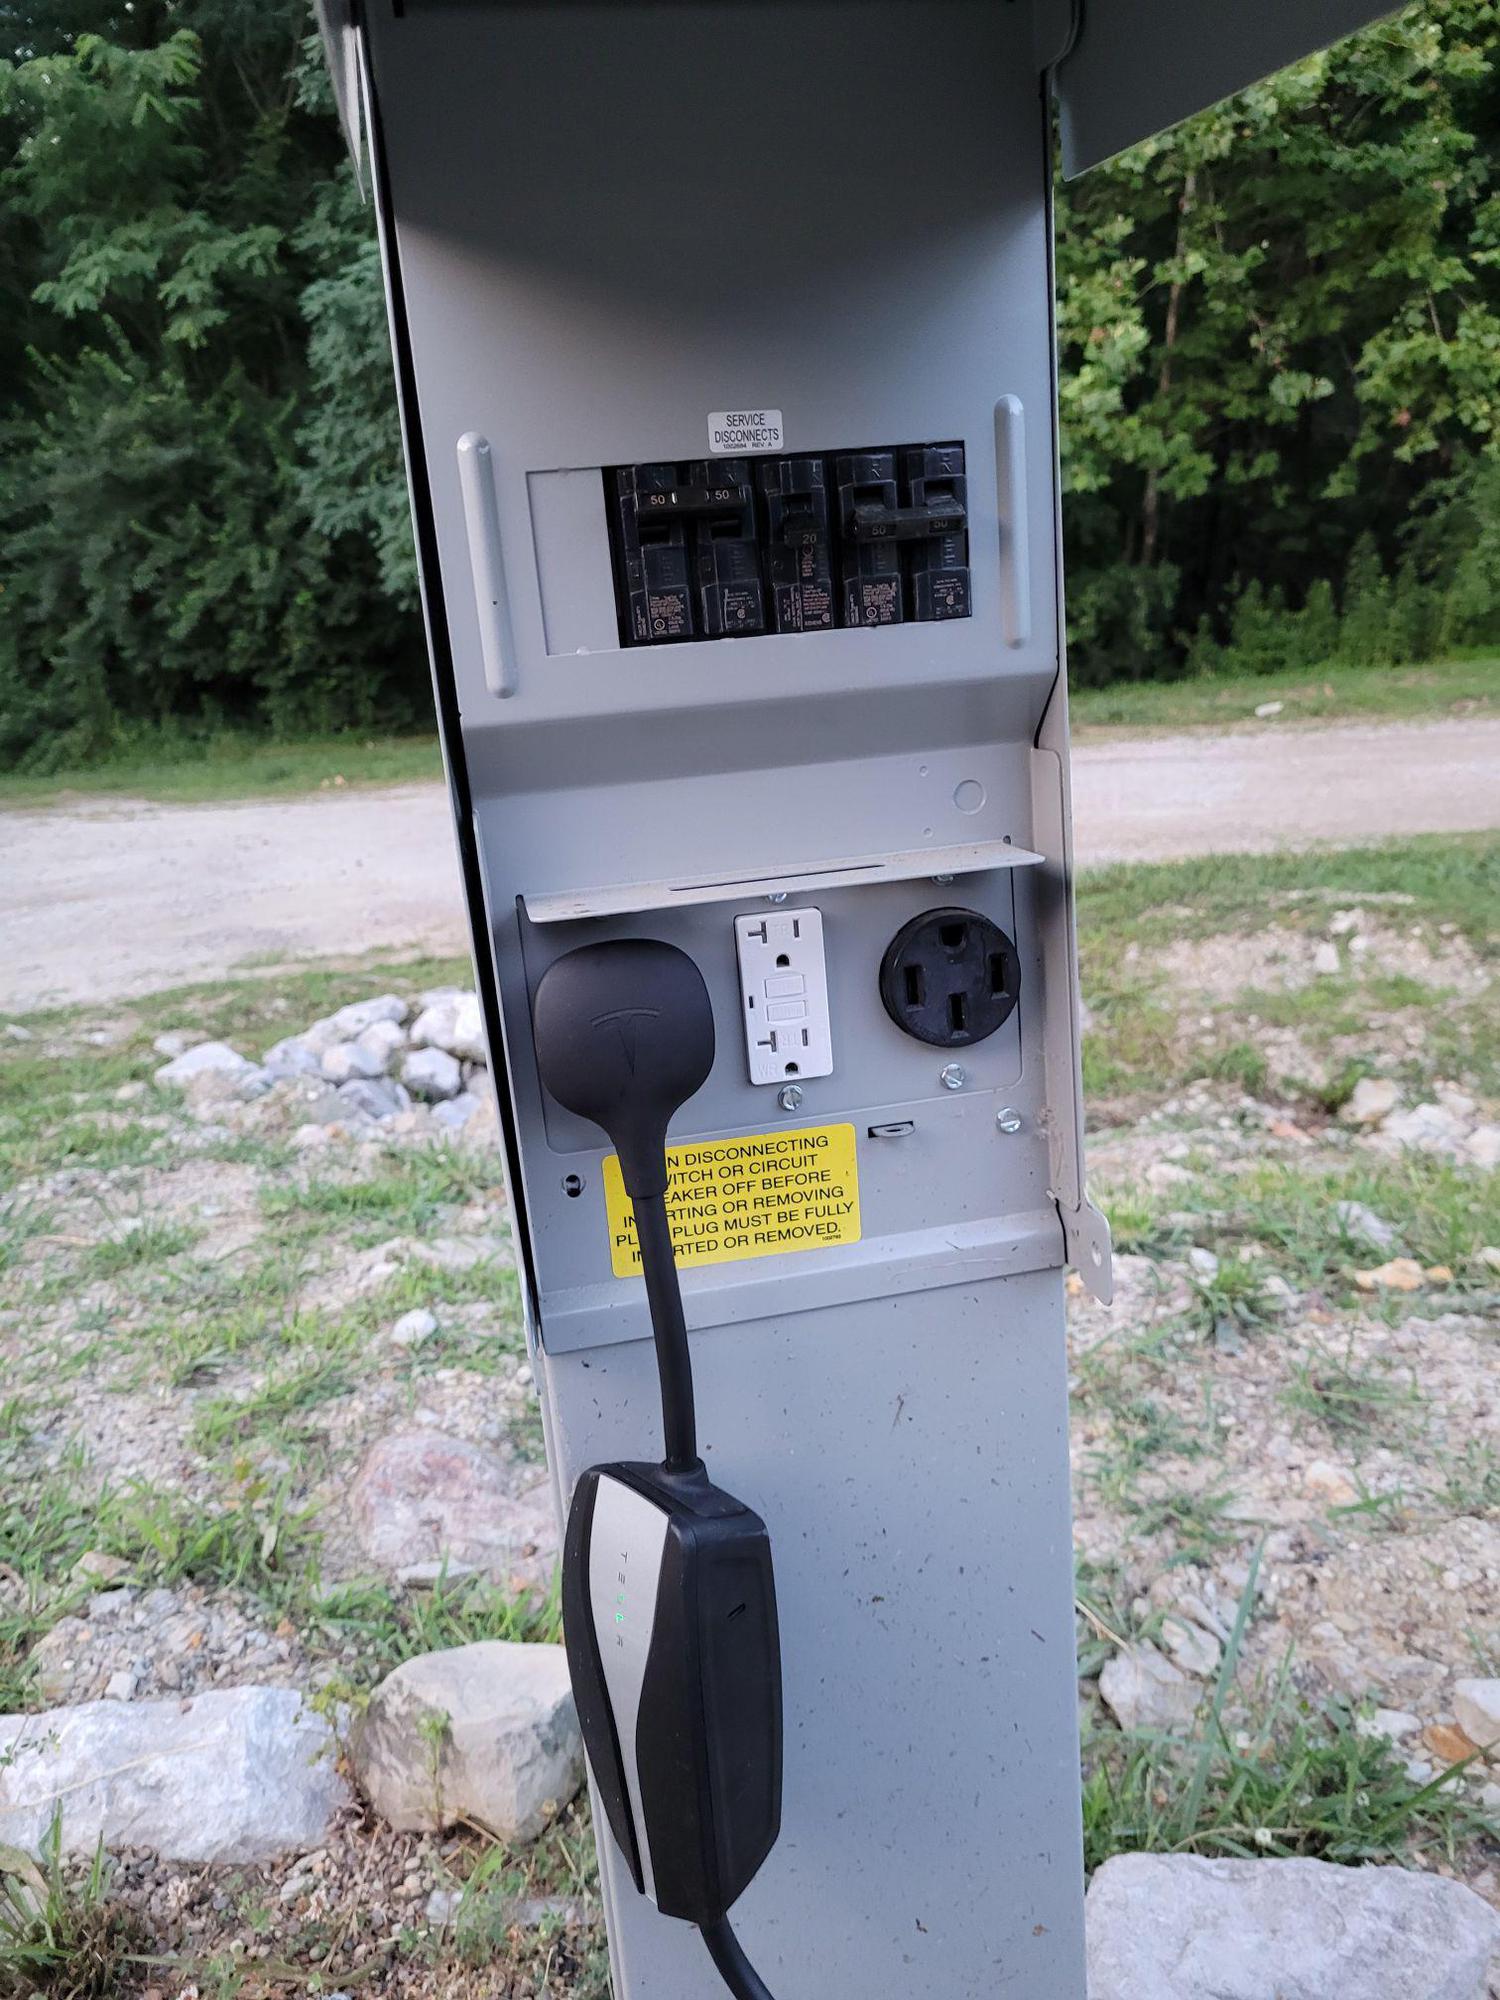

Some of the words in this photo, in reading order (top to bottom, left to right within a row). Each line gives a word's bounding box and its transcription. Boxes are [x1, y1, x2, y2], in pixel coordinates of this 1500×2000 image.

[726, 413, 765, 427] SERVICE
[714, 428, 779, 443] DISCONNECTS
[650, 494, 665, 505] 50
[714, 489, 730, 500] 50
[802, 534, 817, 544] 20
[871, 525, 886, 536] 50
[685, 1135, 829, 1166] DISCONNECTING
[667, 1168, 713, 1186] ITCH
[718, 1164, 744, 1179] OR
[749, 1153, 818, 1175] CIRCUIT
[664, 1186, 717, 1204] EAKER
[722, 1180, 757, 1196] OFF
[762, 1169, 832, 1190] BEFORE
[624, 1203, 717, 1228] INRTING
[722, 1199, 748, 1214] OR
[753, 1185, 844, 1210] REMOVING
[672, 1221, 719, 1239] PLUG
[724, 1213, 772, 1232] MUST
[777, 1209, 800, 1223] BE
[805, 1201, 854, 1220] FULLY
[723, 1234, 749, 1249] OR
[754, 1221, 841, 1245] REMOVED.
